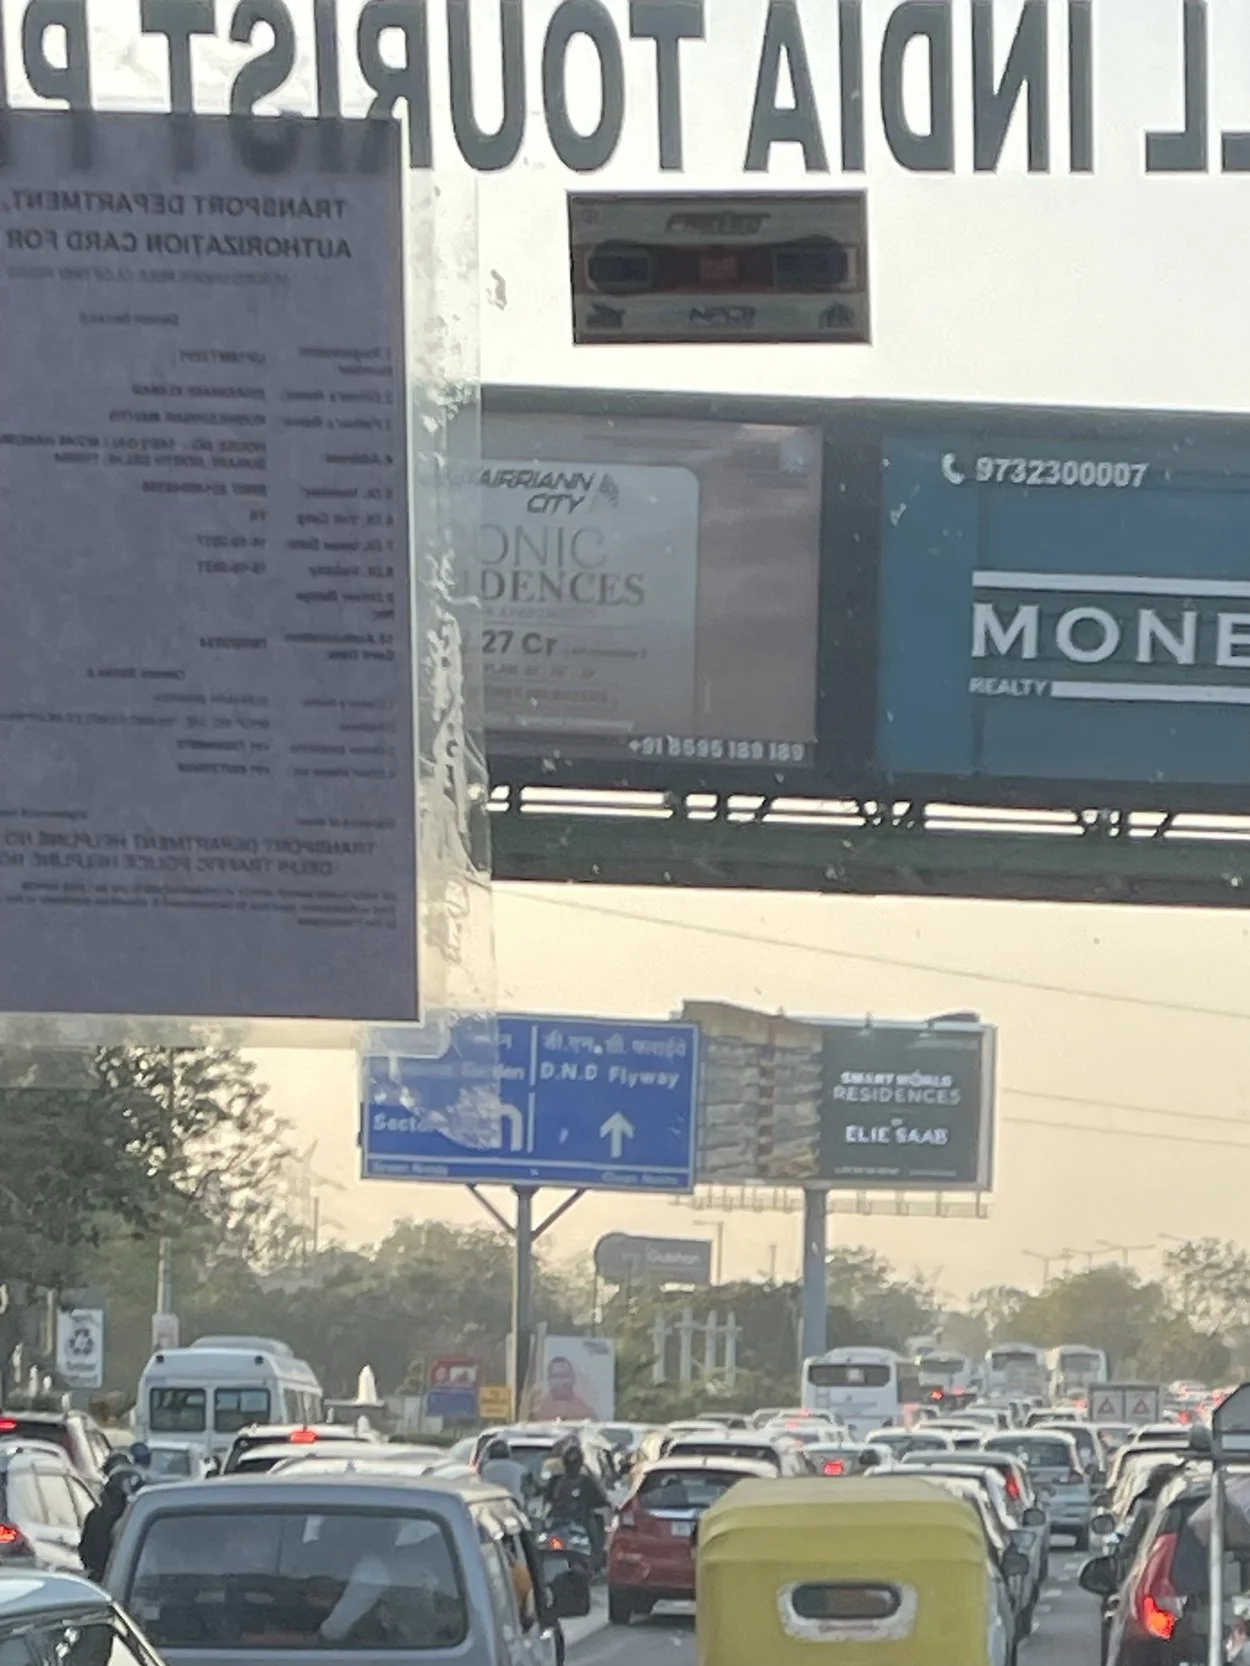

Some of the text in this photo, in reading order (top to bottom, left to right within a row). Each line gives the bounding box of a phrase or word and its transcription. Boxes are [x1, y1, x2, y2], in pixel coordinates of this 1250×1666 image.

[526, 493, 587, 514] CITY
[476, 523, 608, 570] ONIC
[479, 567, 647, 606] DENCES
[521, 631, 559, 657] Cr
[969, 676, 1049, 698] REALTY
[608, 1065, 681, 1090] Flyway
[832, 1085, 962, 1106] RESIDENCES
[845, 1124, 950, 1146] ELIE SAAB
